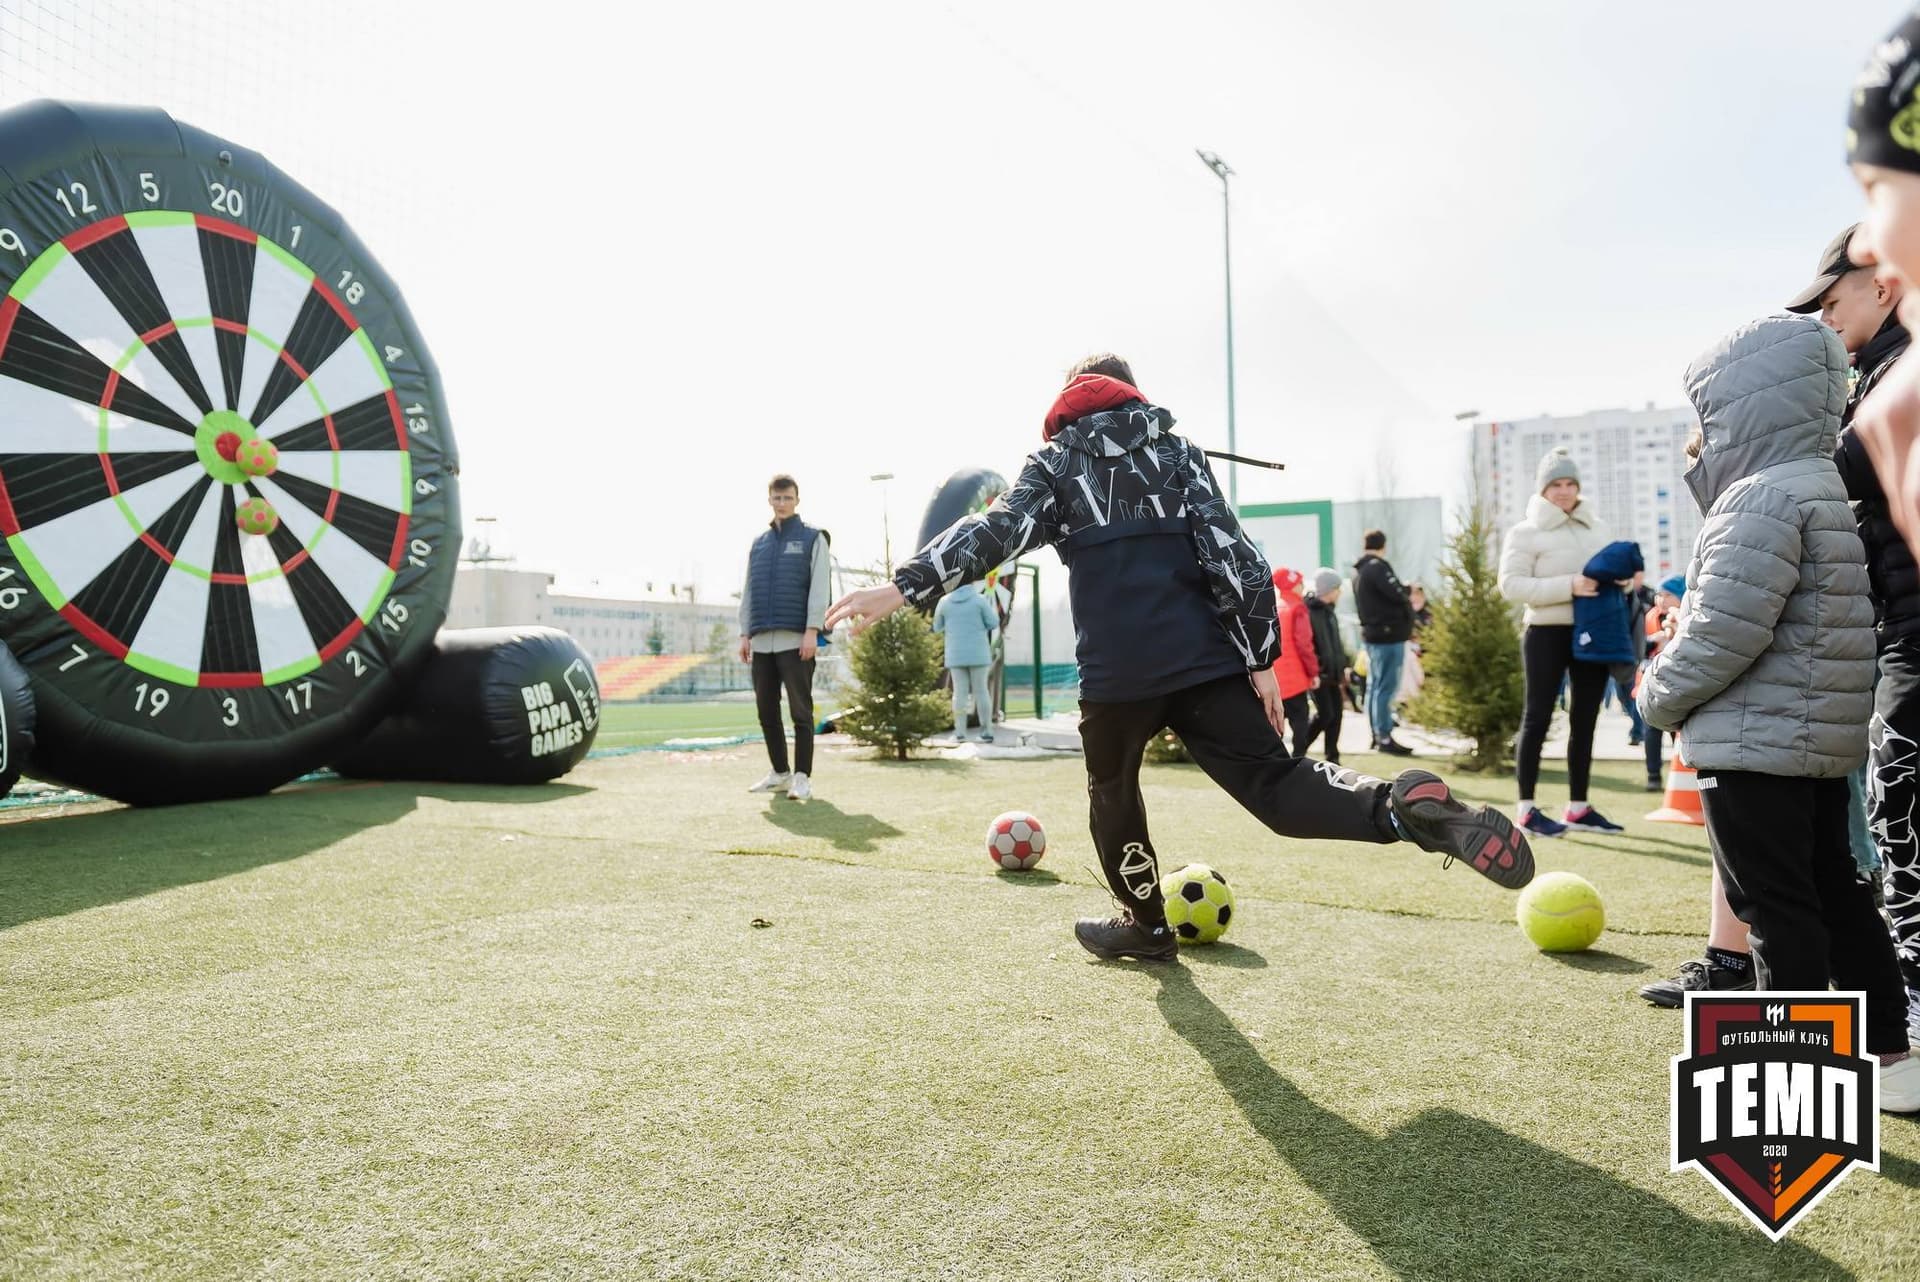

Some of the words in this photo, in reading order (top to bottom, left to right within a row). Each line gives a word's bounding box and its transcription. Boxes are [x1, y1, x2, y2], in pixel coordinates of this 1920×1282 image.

[55, 182, 98, 218] 12
[139, 172, 160, 203] 5
[210, 182, 244, 217] 20
[0, 228, 27, 257] 9
[291, 225, 302, 249] 1
[337, 270, 365, 305] 18
[384, 345, 403, 363] 4
[405, 402, 429, 434] 13
[408, 539, 432, 568] 10
[381, 598, 409, 631] 15
[59, 643, 89, 672] 7
[345, 650, 367, 677] 2
[134, 682, 170, 717] 19
[285, 681, 312, 714] 17
[521, 682, 554, 710] BIG
[222, 697, 240, 727] 3
[528, 701, 572, 735] PAPA
[531, 721, 583, 757] GAMES
